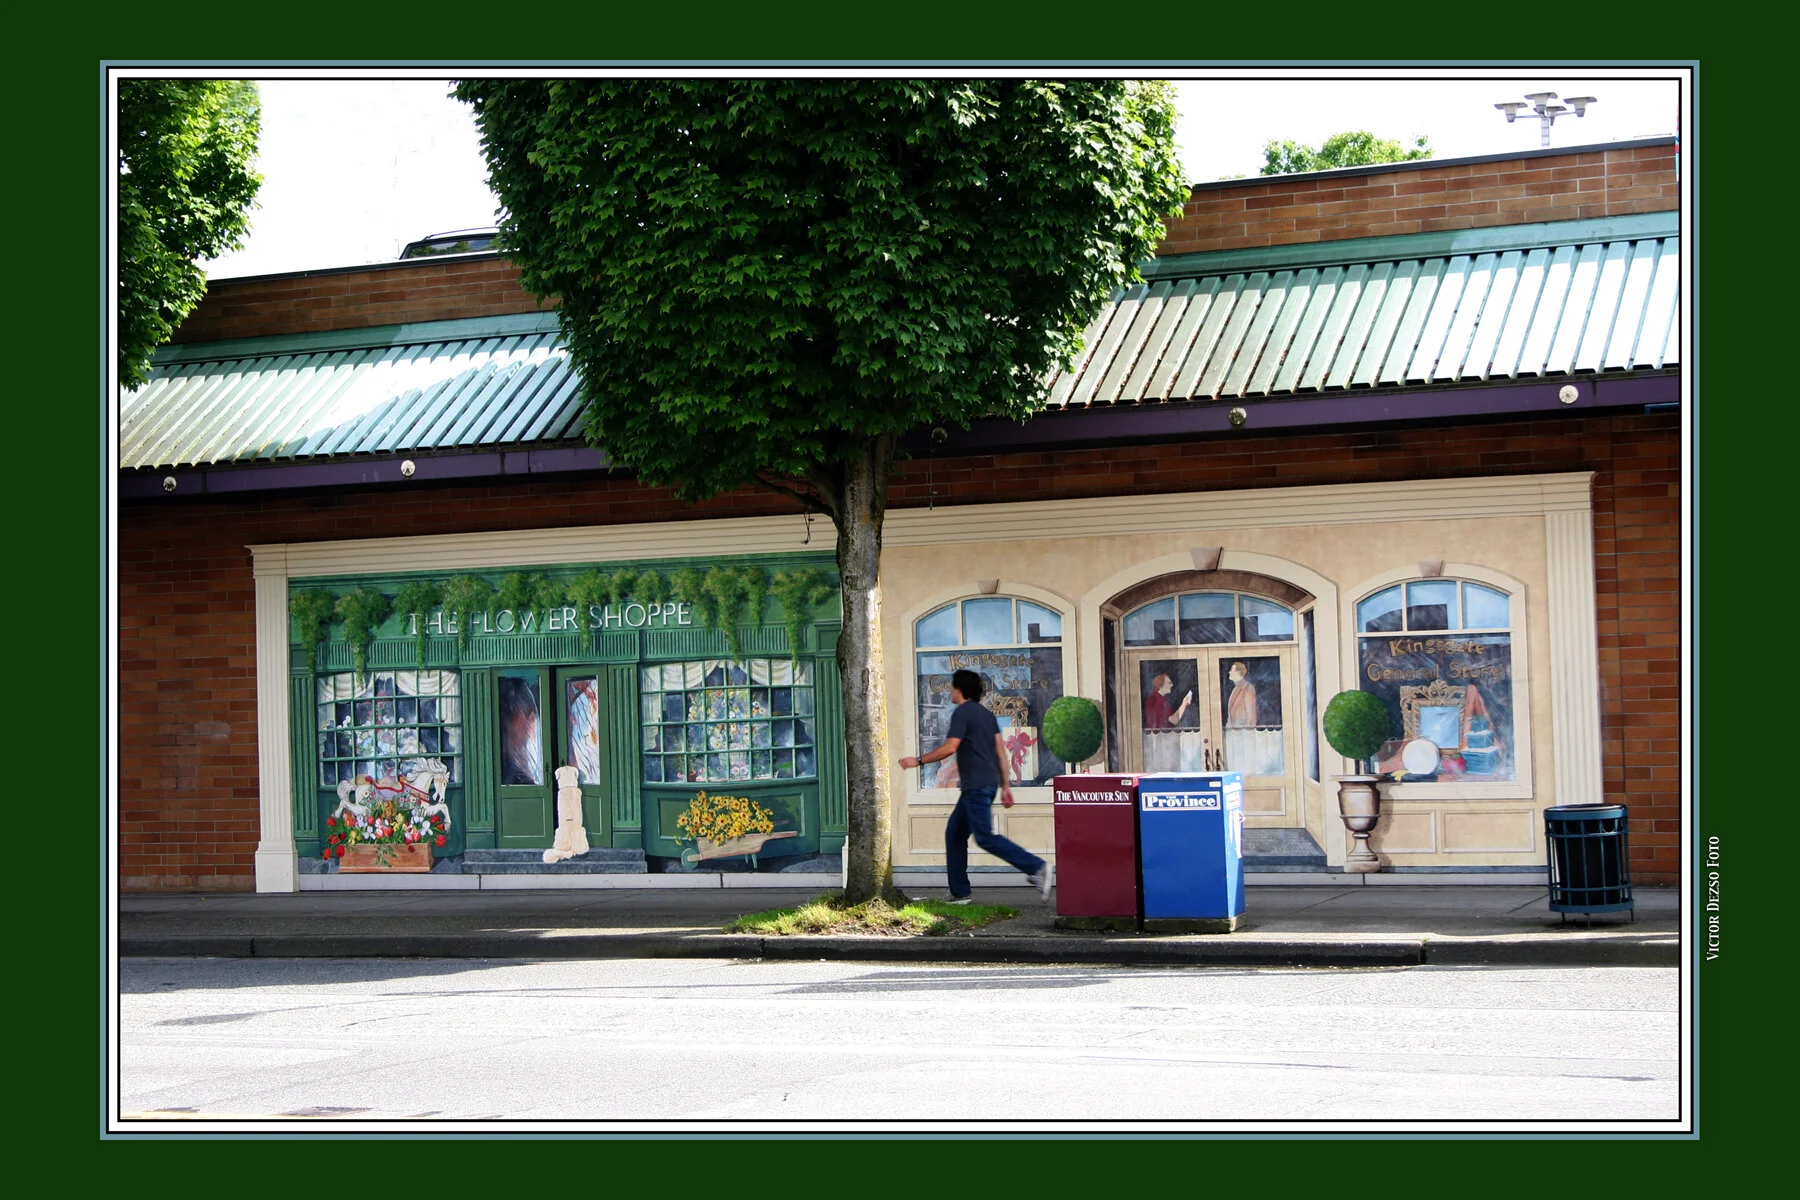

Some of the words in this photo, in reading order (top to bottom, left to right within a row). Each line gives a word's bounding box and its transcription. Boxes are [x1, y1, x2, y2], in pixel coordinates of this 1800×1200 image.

[409, 611, 459, 635] THE
[469, 606, 579, 633] FLOWER
[589, 602, 692, 629] SHOPPE
[1389, 639, 1486, 657] Kingsgate
[949, 653, 1034, 670] Kingsgate
[1366, 663, 1440, 681] General
[1448, 661, 1503, 679] Store
[930, 675, 995, 694] Geal
[1001, 673, 1049, 690] Store
[1056, 790, 1072, 801] THE
[1071, 790, 1114, 801] VANCOUVER
[1114, 790, 1130, 801] SUN
[1146, 795, 1216, 808] Province
